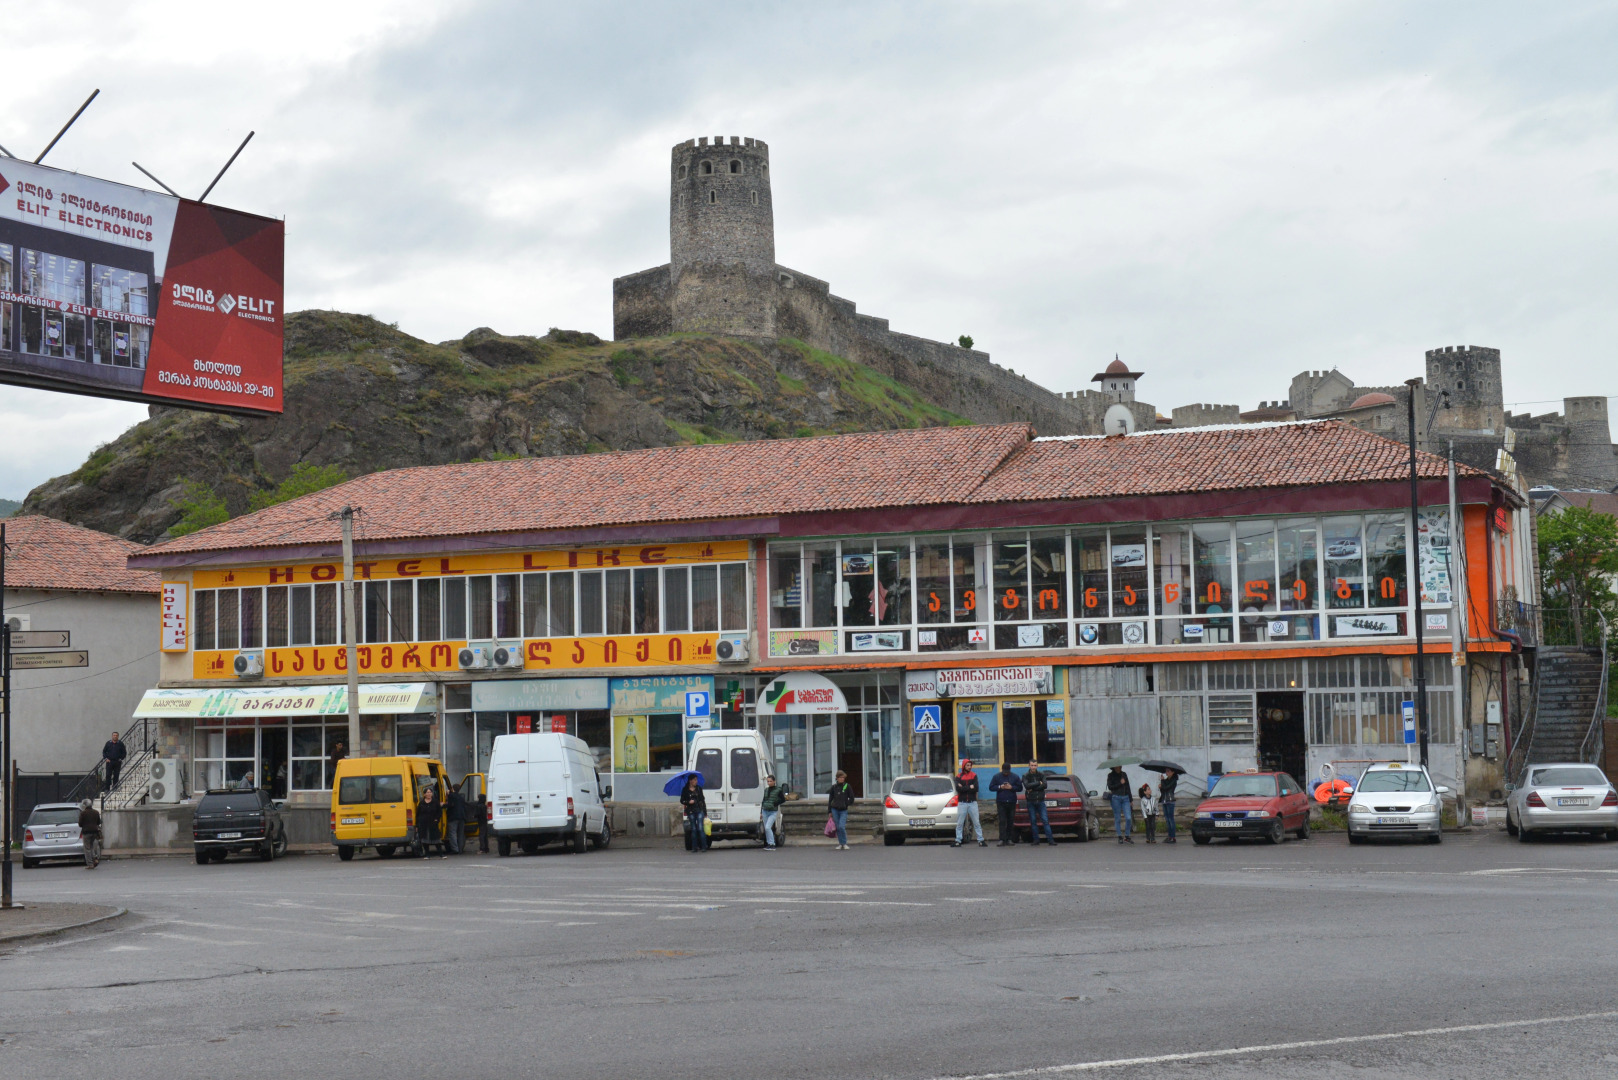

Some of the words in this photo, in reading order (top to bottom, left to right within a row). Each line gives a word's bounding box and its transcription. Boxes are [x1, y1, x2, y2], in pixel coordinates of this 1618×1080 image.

[17, 181, 53, 200] ელიტ
[61, 192, 153, 226] ელექტრონიქსი
[17, 199, 50, 217] ELIT
[58, 210, 153, 242] ELECTRONICS
[172, 283, 215, 304] ელიტ
[72, 304, 92, 315] ELIT
[97, 309, 156, 326] ELECTRONICS
[237, 295, 275, 315] ELIT
[237, 311, 275, 323] ELECTRONICS
[193, 359, 242, 377] მხოლოდ
[158, 370, 191, 386] მერაბ
[193, 376, 243, 393] კოსტავას
[270, 558, 464, 583] HOTEL
[523, 546, 668, 570] LIKE
[163, 588, 175, 628] HOTEL
[174, 614, 186, 644] LIKE
[272, 644, 451, 673] სასტუმრო
[528, 637, 682, 665] ლაიქი
[623, 676, 702, 688] გულისტანი
[797, 688, 834, 697] სახალხო
[242, 698, 315, 710] მარკეტი
[689, 693, 705, 716] P
